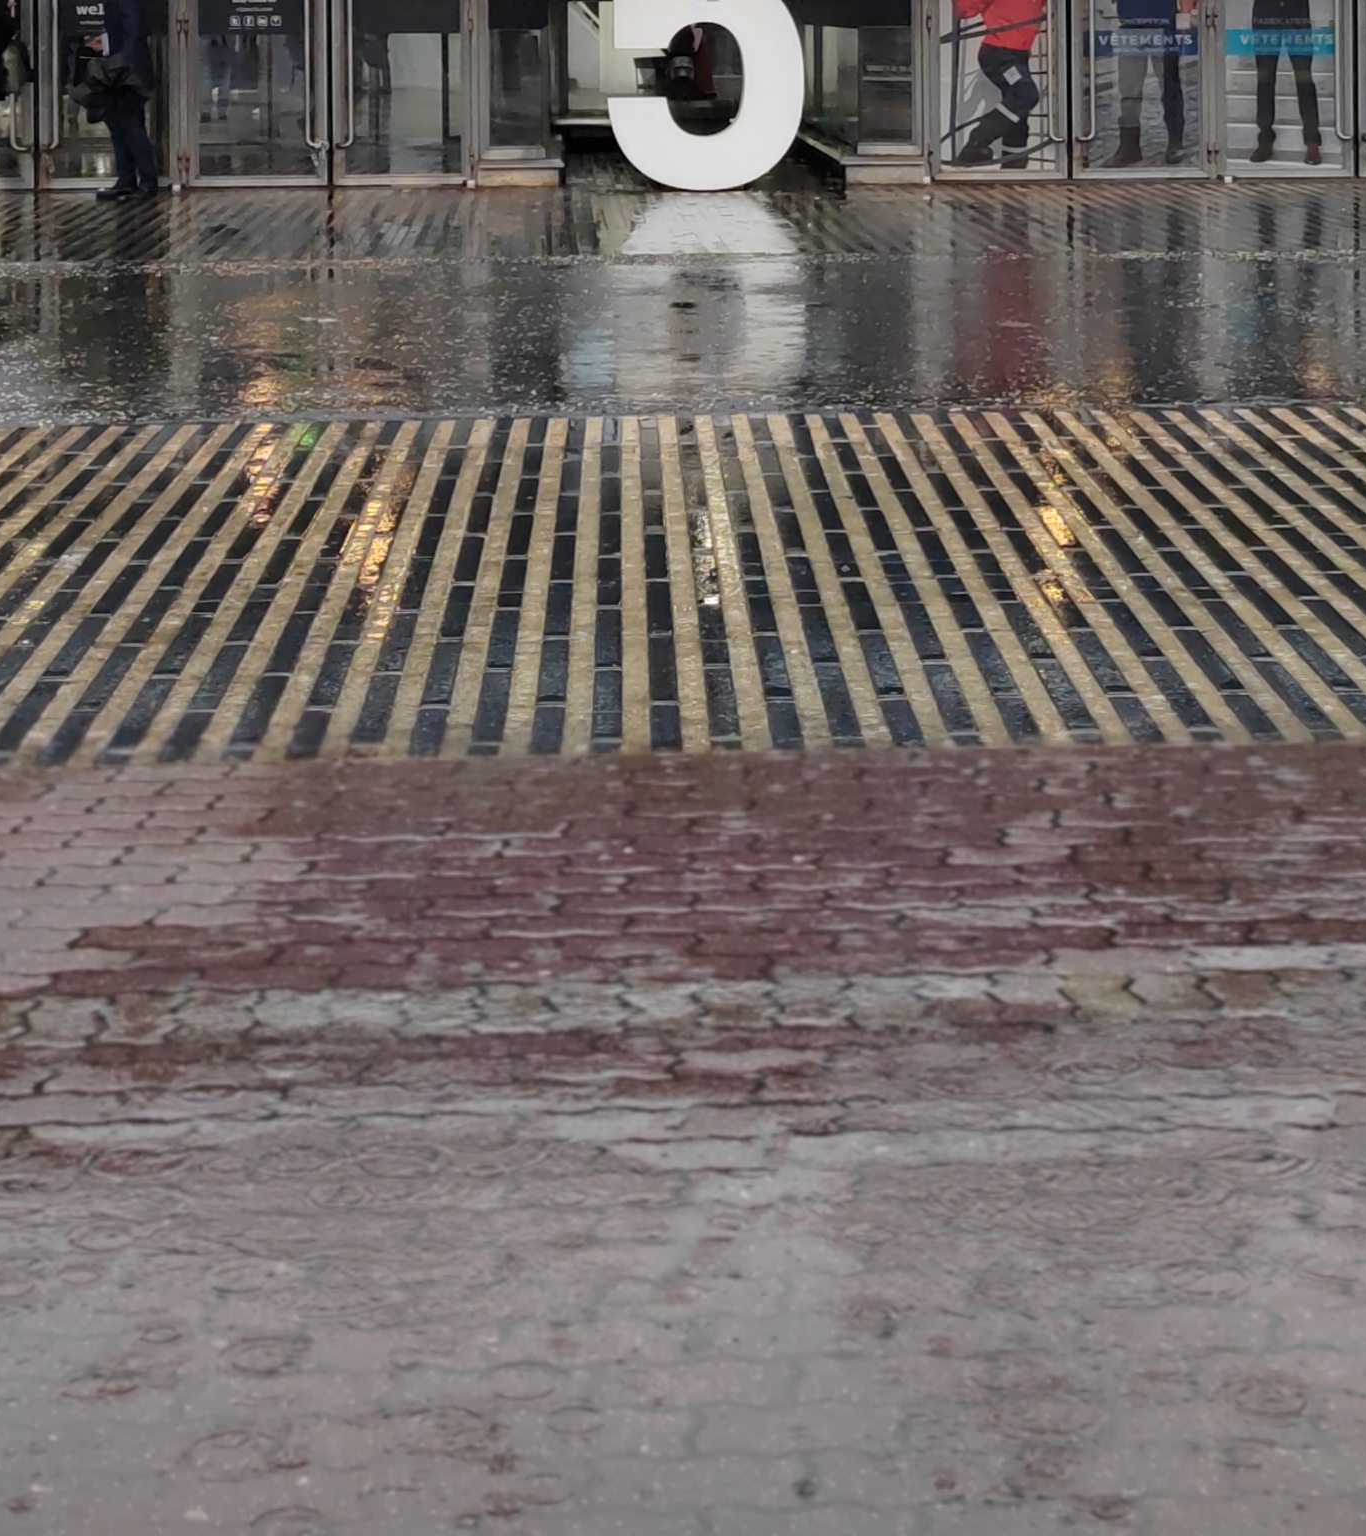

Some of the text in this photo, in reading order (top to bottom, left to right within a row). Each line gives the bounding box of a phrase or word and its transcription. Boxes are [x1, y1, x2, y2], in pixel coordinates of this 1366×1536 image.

[75, 3, 105, 16] wel
[1098, 32, 1194, 46] VÊTEMENTS
[1239, 32, 1334, 45] VÊTEMENTS
